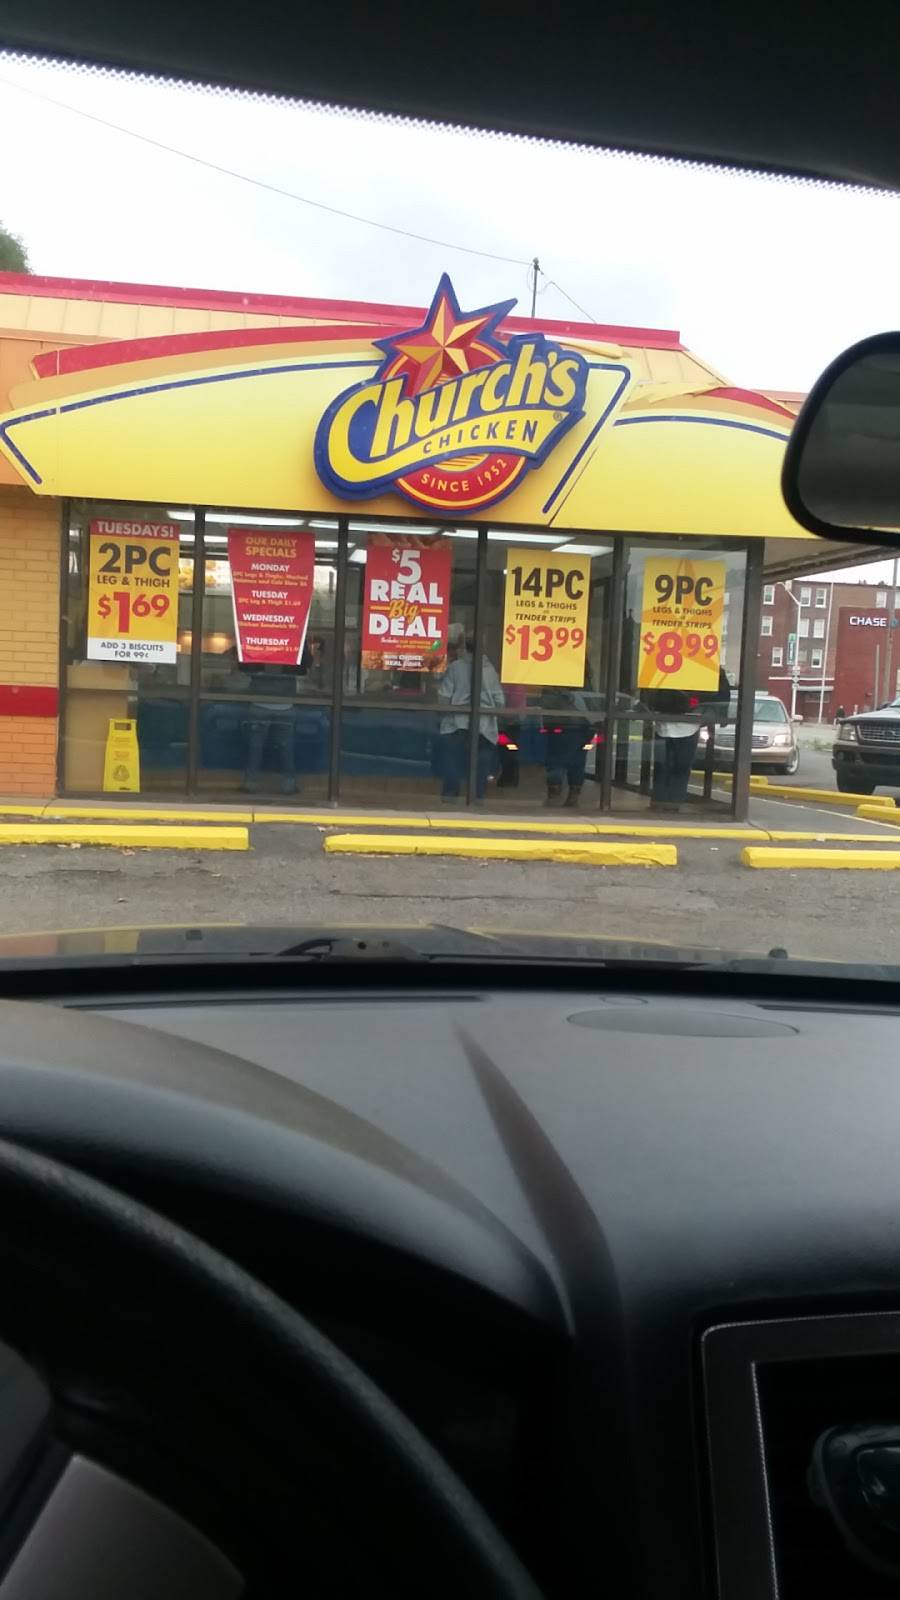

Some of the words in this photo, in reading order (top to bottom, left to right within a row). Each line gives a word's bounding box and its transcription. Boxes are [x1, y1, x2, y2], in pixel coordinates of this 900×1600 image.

[328, 344, 579, 482] Church's
[423, 419, 538, 454] CHICKEN
[420, 473, 470, 492] SINCE
[477, 458, 508, 487] 1952
[97, 521, 174, 538] TUESDAYS!
[245, 537, 268, 546] OUR
[270, 538, 297, 548] DAILY
[245, 546, 297, 559] SPECIALS
[98, 542, 171, 577] 2PC
[251, 563, 290, 573] MONDAY
[392, 548, 422, 585] $5
[97, 575, 118, 585] LEG
[121, 577, 129, 586] &
[134, 577, 170, 588] THIGH
[511, 566, 584, 600] 14PC
[251, 590, 289, 599] TUESDAY
[370, 579, 443, 605] REAL
[655, 574, 713, 607] 9PC
[389, 598, 419, 624] Big
[516, 600, 536, 608] LEGS
[546, 602, 577, 610] THIGHS
[242, 613, 295, 624] WEDNESDAY
[515, 613, 546, 621] TENDER
[549, 615, 576, 624] STRIPS
[682, 608, 712, 616] THIGHS
[369, 613, 442, 638] DEAL
[652, 619, 683, 627] TENDER
[685, 621, 712, 629] STRIPS
[849, 616, 887, 627] CHASE
[101, 642, 118, 650] ADD
[129, 643, 164, 652] BISCUITS
[245, 636, 290, 646] THURSDAY
